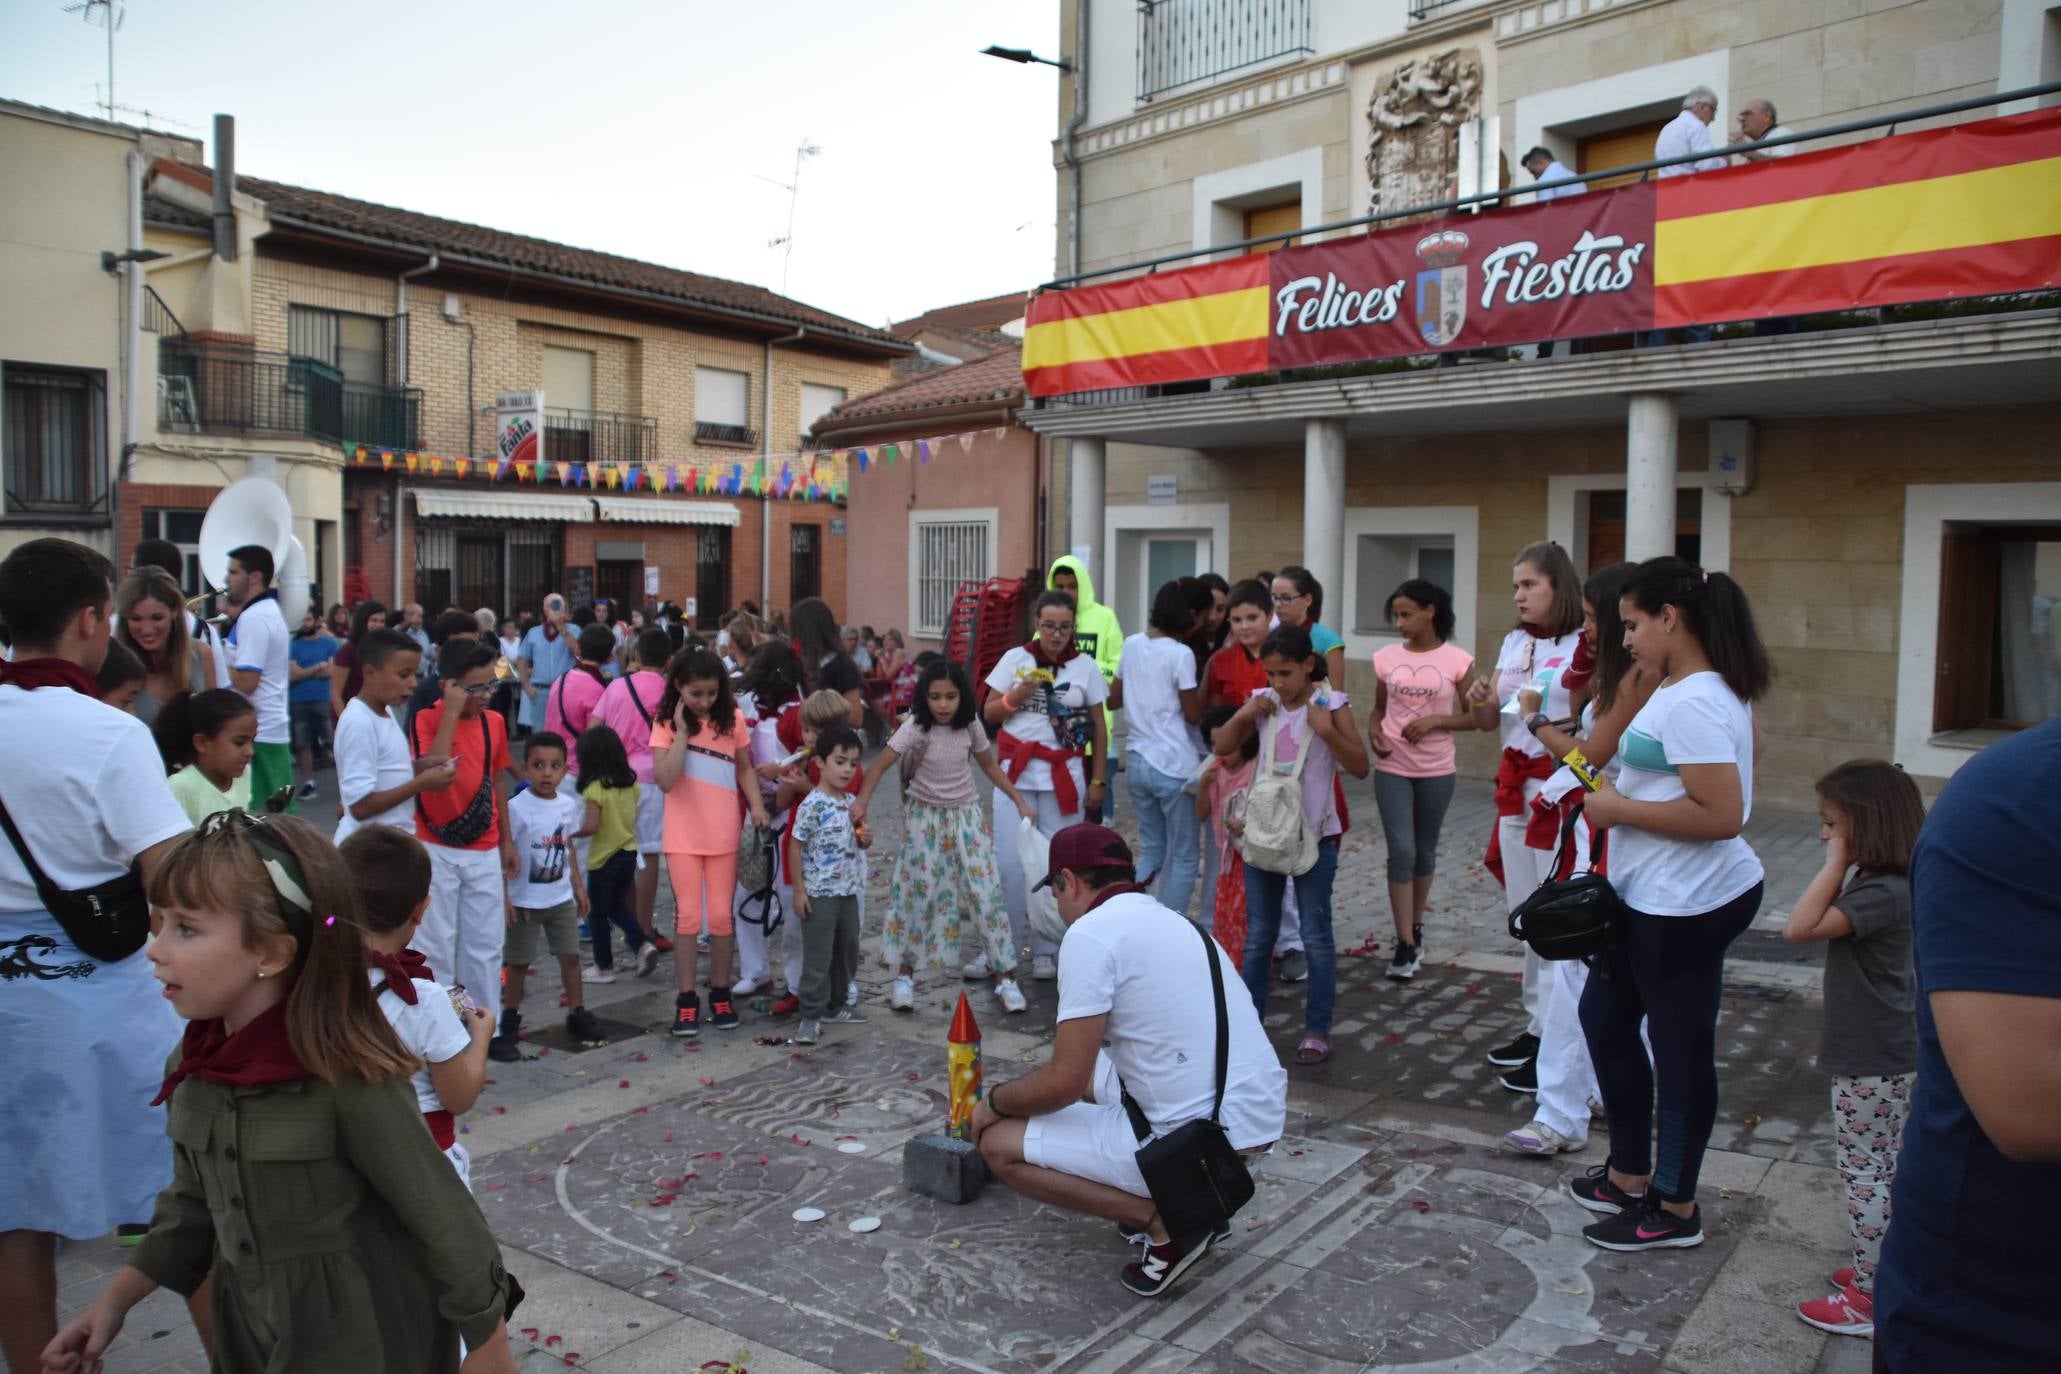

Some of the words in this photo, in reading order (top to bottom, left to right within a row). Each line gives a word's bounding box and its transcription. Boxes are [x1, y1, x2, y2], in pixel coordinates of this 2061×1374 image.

[1276, 271, 1406, 337] Felices
[1481, 230, 1646, 310] Fiestas
[499, 419, 533, 457] Fanta
